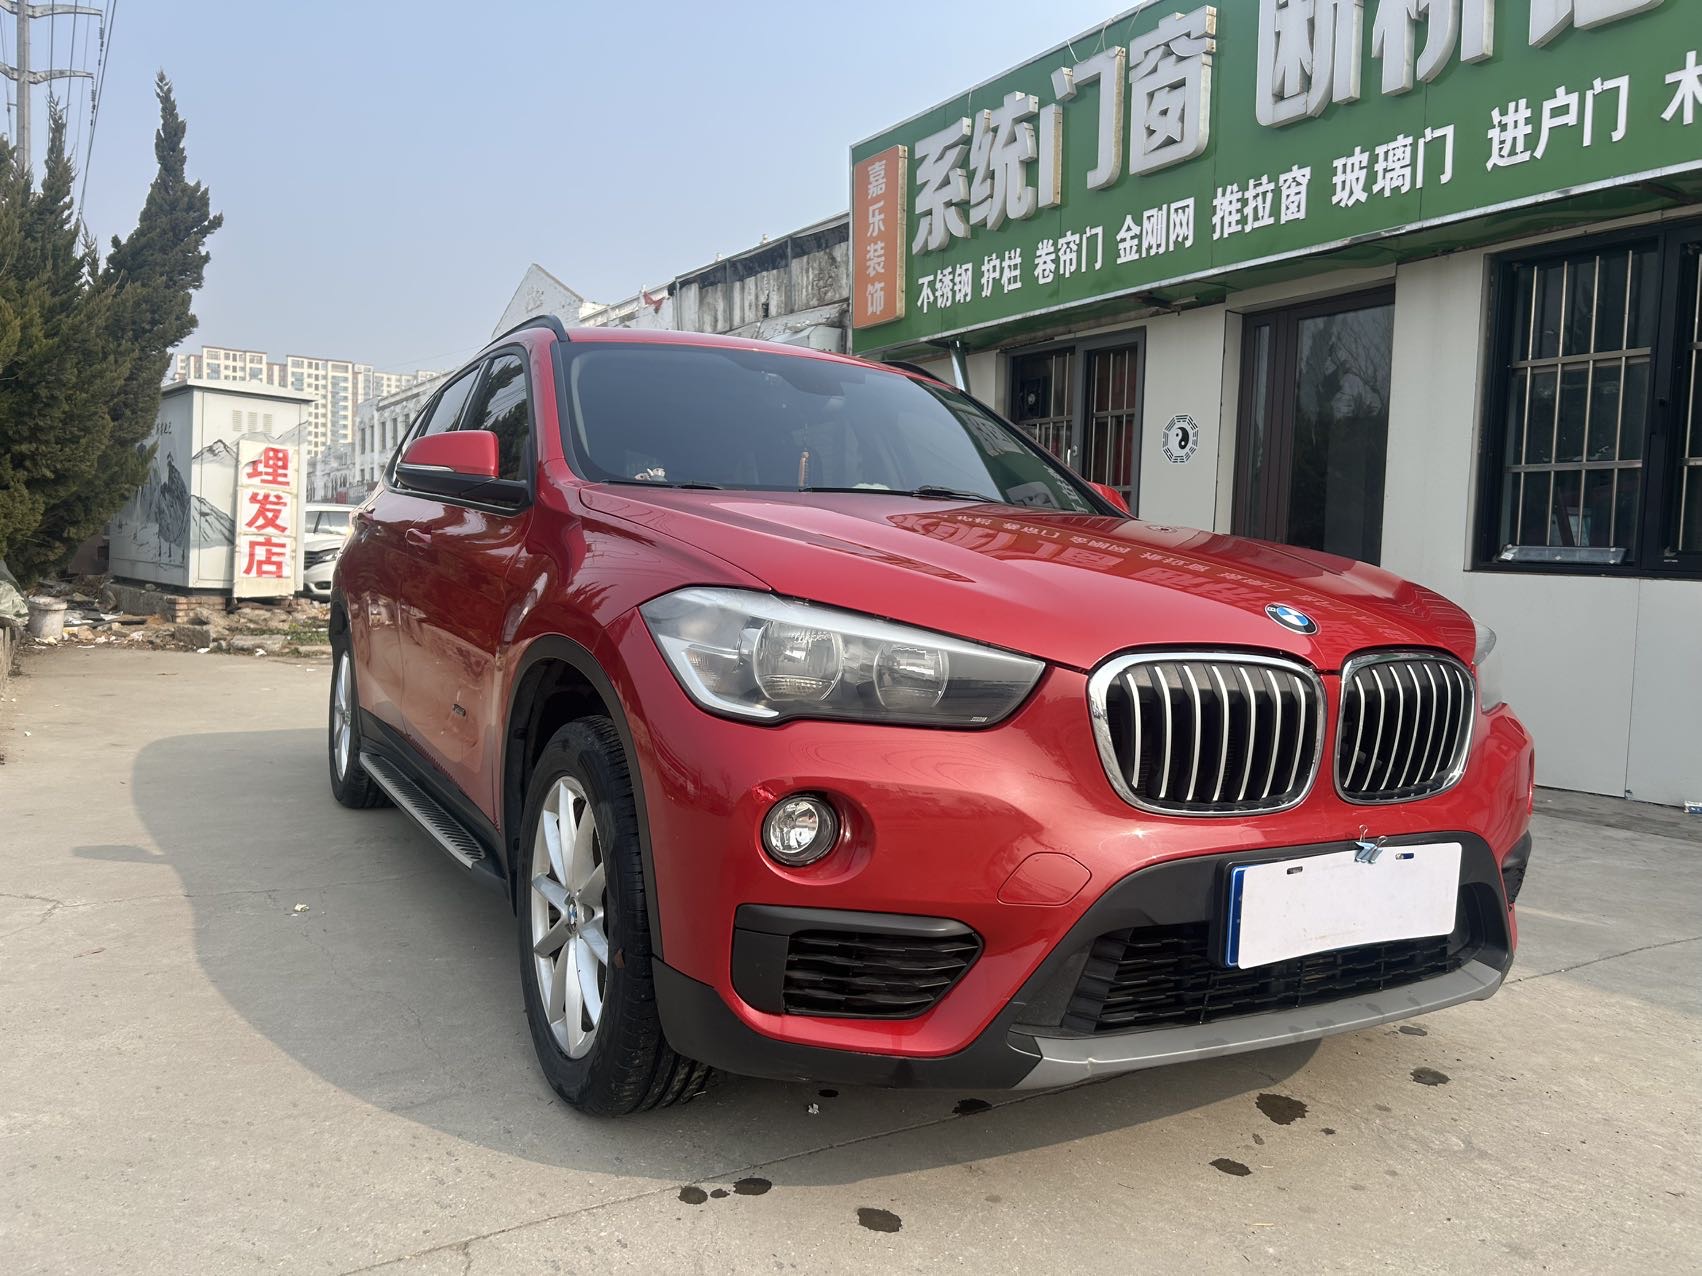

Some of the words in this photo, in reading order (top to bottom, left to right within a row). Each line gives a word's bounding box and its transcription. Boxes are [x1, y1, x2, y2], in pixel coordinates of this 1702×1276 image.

[912, 5, 1217, 256] 系统门窗
[916, 262, 973, 314] 不锈钢
[980, 247, 1022, 298] 护栏
[1034, 225, 1104, 285] 卷帘门
[1115, 197, 1195, 265] 金刚网
[1211, 164, 1312, 241] 推拉窗
[1331, 124, 1455, 208] 玻璃门
[1485, 74, 1631, 172] 进户门
[866, 159, 887, 316] 嘉乐装饰
[243, 447, 290, 578] 理发店
